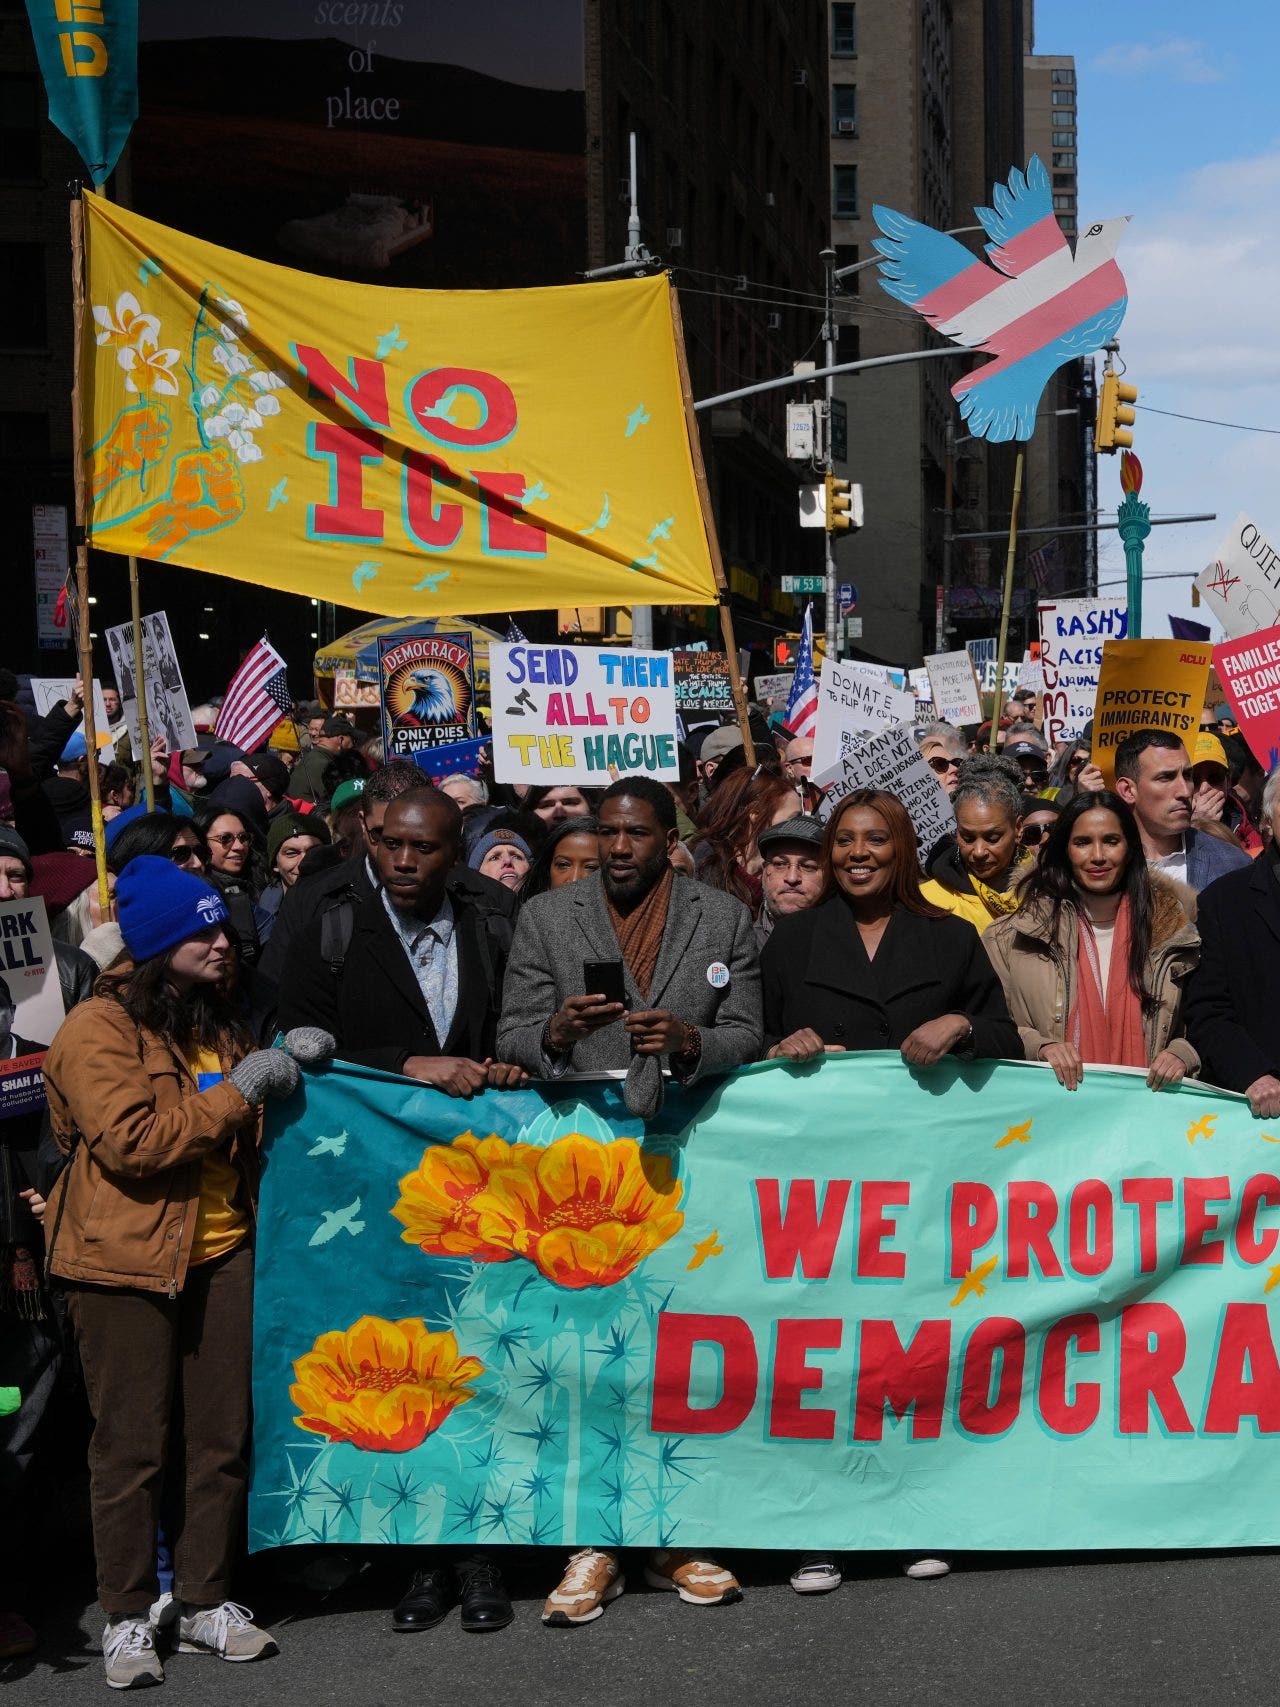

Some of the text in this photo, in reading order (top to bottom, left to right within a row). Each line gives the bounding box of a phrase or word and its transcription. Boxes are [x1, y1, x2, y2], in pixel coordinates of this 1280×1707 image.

[313, 0, 404, 26] scents
[348, 40, 376, 73] of
[325, 86, 400, 128] place
[289, 342, 518, 452] NO
[306, 420, 547, 560] ICE
[793, 578, 800, 590] W
[803, 578, 814, 591] 53
[384, 641, 467, 670] DEMOCRACY
[1179, 654, 1206, 666] ACLU
[506, 646, 670, 687] SEND THEM
[674, 685, 732, 700] BECAUSE
[833, 671, 893, 710] DONATE
[1103, 689, 1191, 709] PROTECT
[546, 692, 651, 726] ALL TO
[683, 699, 734, 708] LOVE AMERICA
[841, 694, 859, 709] FLIP
[915, 703, 933, 713] END
[1100, 710, 1195, 731] IMMIGRANTS'
[397, 726, 465, 741] ONLY DIES
[1098, 730, 1134, 748] RIG
[395, 742, 407, 754] IF
[508, 732, 677, 771] THE HAGUE
[842, 759, 854, 775] A
[854, 735, 890, 764] MAN
[826, 738, 913, 803] PEACE DOES NOT
[884, 778, 906, 792] THE
[897, 774, 935, 799] ITIZENS,
[910, 798, 939, 822] NCITE
[202, 905, 227, 925] UFT
[13, 1057, 41, 1069] SAVED
[1, 1073, 46, 1092] SHAH AL
[2, 1097, 33, 1108] colluded
[10, 1088, 41, 1100] husband
[754, 1178, 910, 1283] WE
